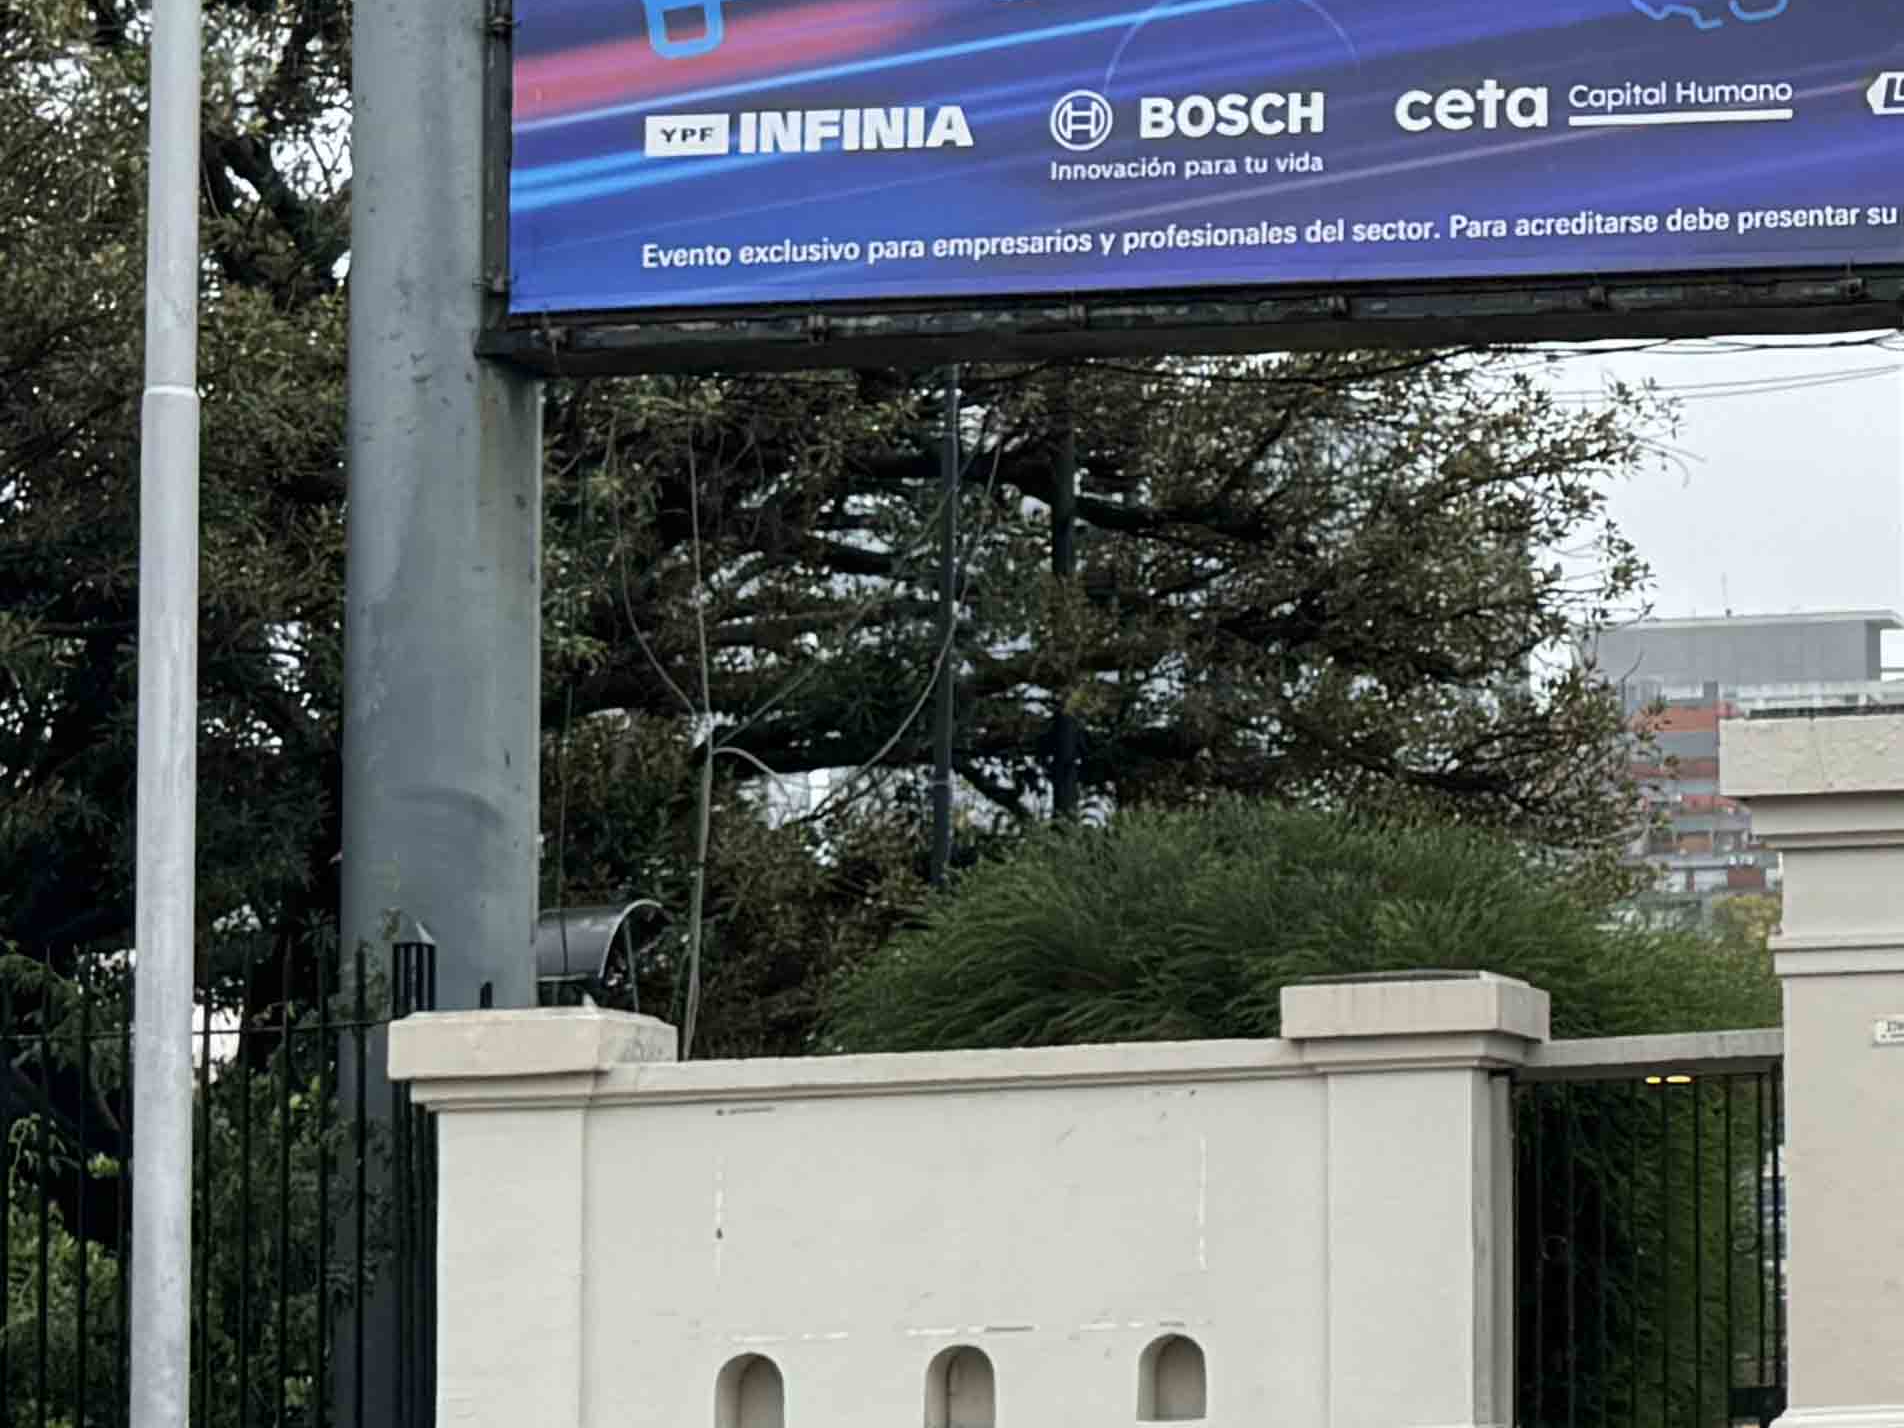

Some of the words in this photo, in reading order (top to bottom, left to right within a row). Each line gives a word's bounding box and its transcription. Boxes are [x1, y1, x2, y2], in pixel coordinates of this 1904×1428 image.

[1139, 91, 1325, 140] BOSCH
[1395, 79, 1548, 132] ceta
[1568, 80, 1667, 111] Capital
[1675, 79, 1793, 107] Humano
[659, 126, 716, 145] YPF
[738, 105, 974, 154] INFINIA
[1050, 155, 1175, 182] Innovación
[1184, 156, 1238, 181] para
[1244, 154, 1268, 176] tu
[1274, 152, 1324, 174] vida
[642, 243, 733, 270] Evento
[738, 236, 860, 266] exclusivo
[867, 238, 926, 265] para
[932, 229, 1093, 262] empresarios
[1100, 233, 1117, 255] y
[1122, 221, 1298, 254] profesionales
[1305, 218, 1345, 244] del
[1352, 217, 1442, 244] sector.
[1448, 213, 1508, 241] Para
[1514, 208, 1659, 237] acreditarse
[1665, 205, 1731, 234] debe
[1736, 201, 1861, 232] presentar
[1866, 204, 1898, 225] su
